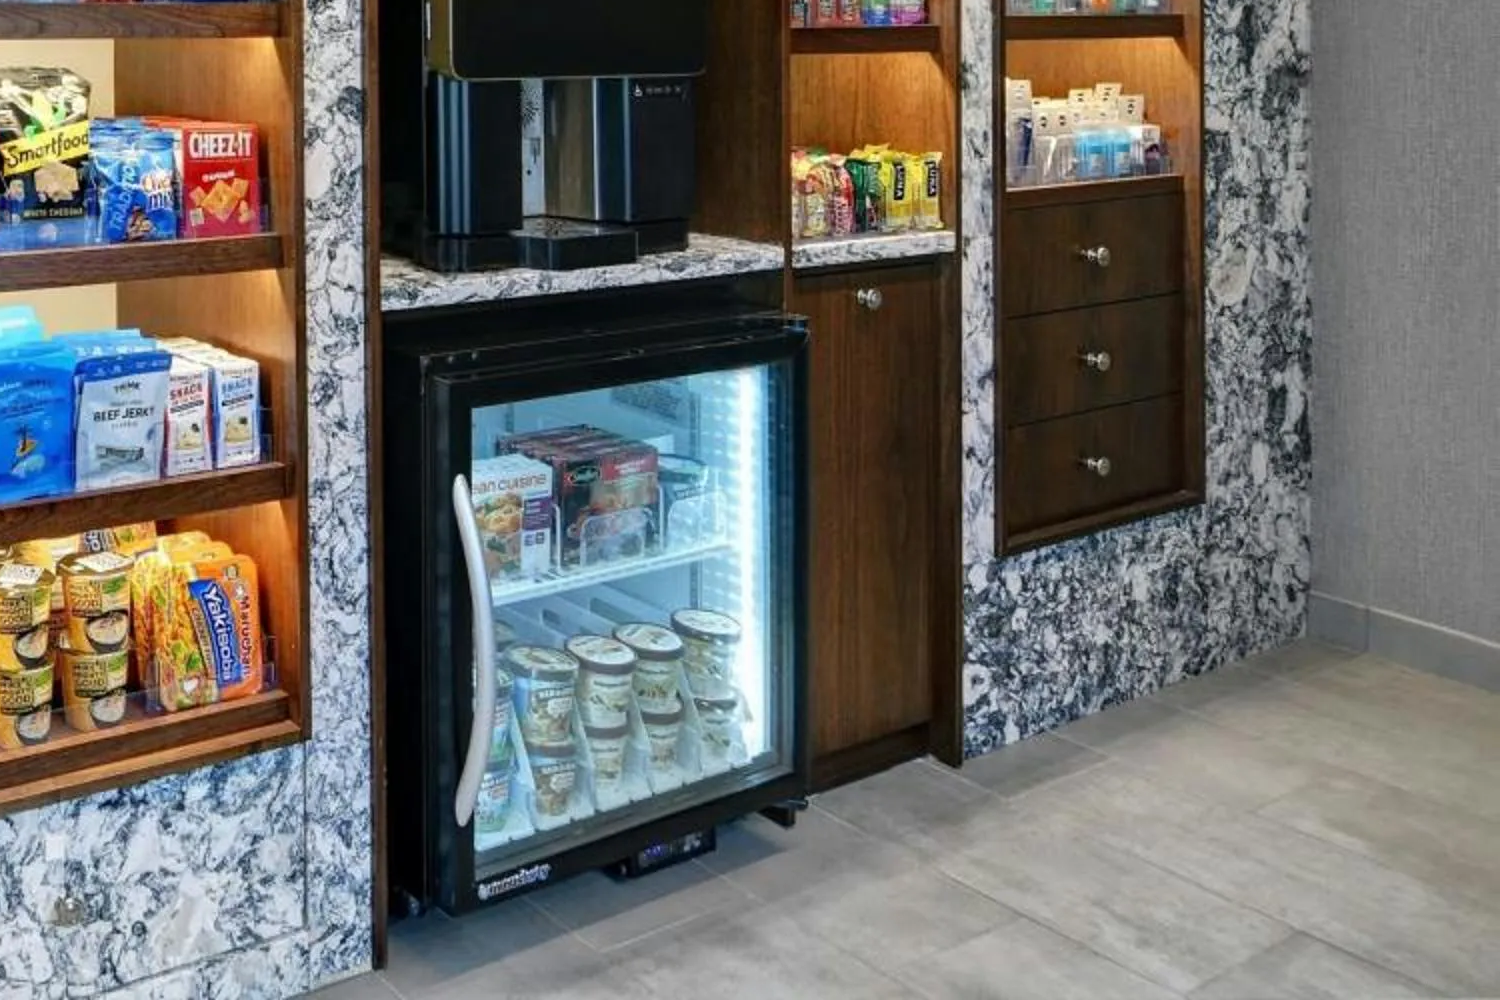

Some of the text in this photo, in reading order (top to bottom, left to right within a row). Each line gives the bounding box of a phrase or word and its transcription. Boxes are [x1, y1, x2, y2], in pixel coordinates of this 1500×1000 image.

[5, 128, 89, 169] Smartfood
[93, 406, 156, 422] BEEF JERKY
[203, 585, 237, 682] Yakisoba
